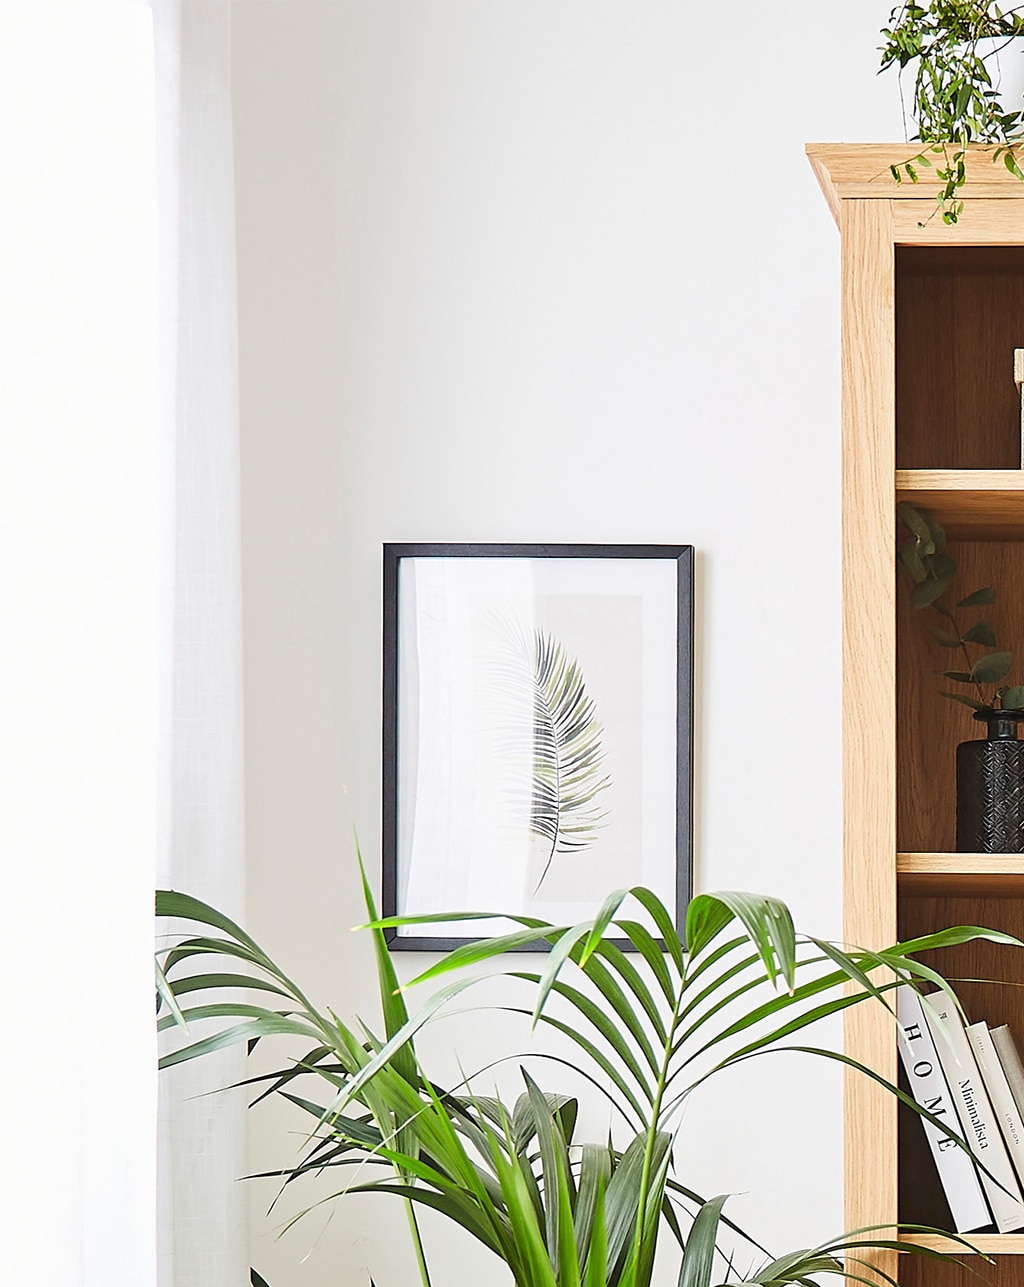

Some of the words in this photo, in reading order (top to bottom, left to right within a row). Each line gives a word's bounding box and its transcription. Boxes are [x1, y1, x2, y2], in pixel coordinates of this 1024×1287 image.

[903, 1022, 958, 1153] HOME
[958, 1078, 990, 1151] Minimalista
[1004, 1112, 1020, 1146] LONDON
